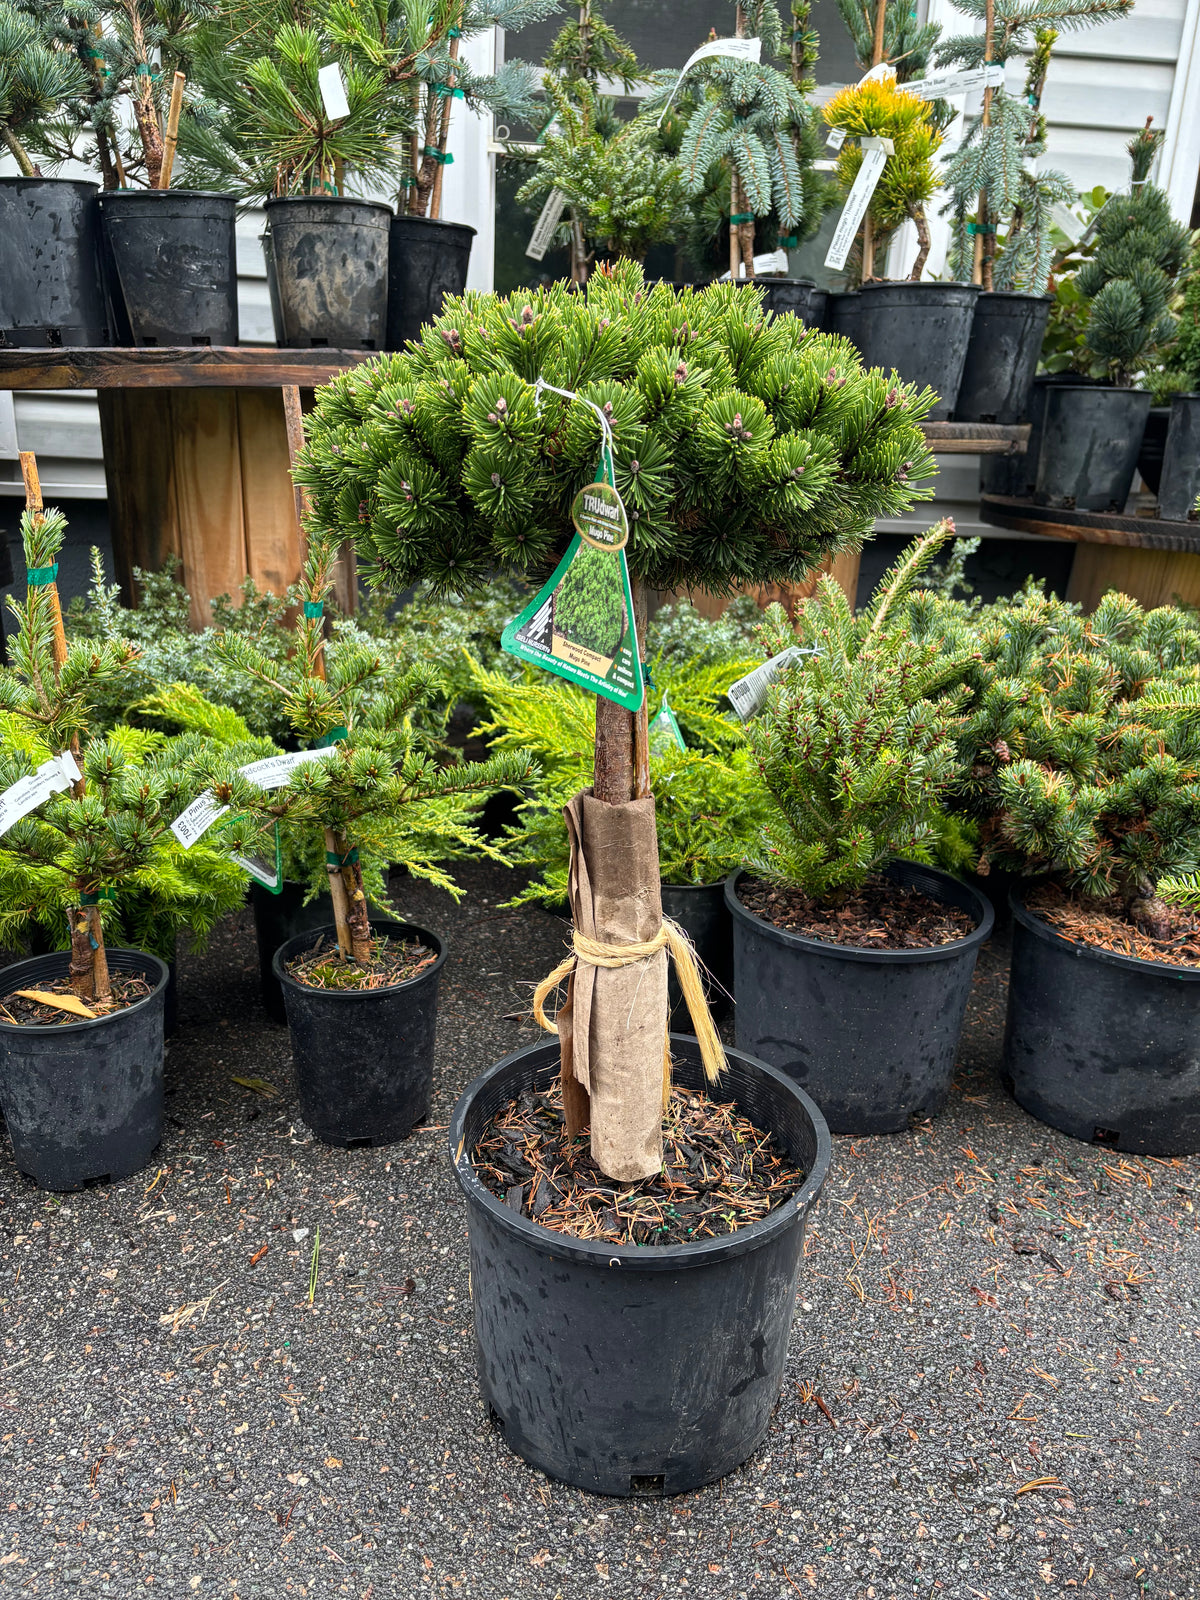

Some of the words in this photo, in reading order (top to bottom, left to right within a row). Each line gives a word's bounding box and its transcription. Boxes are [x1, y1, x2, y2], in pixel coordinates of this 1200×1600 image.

[589, 525, 603, 540] Mugo
[603, 530, 614, 543] Pine
[515, 633, 528, 643] ISELI
[563, 641, 583, 654] Sherwood
[583, 650, 601, 662] Compact
[569, 652, 580, 663] Mugo
[580, 658, 590, 667] Pine
[623, 648, 632, 658] easy
[520, 644, 534, 655] Where
[534, 650, 542, 658] the
[542, 654, 557, 666] Beauty
[562, 663, 576, 674] Nature
[576, 669, 589, 680] Meets
[590, 675, 598, 683] The
[598, 680, 613, 692] Artistry
[612, 672, 617, 680] &
[617, 676, 635, 689] compact
[188, 799, 207, 817] Pinus
[177, 820, 191, 840] 7003
